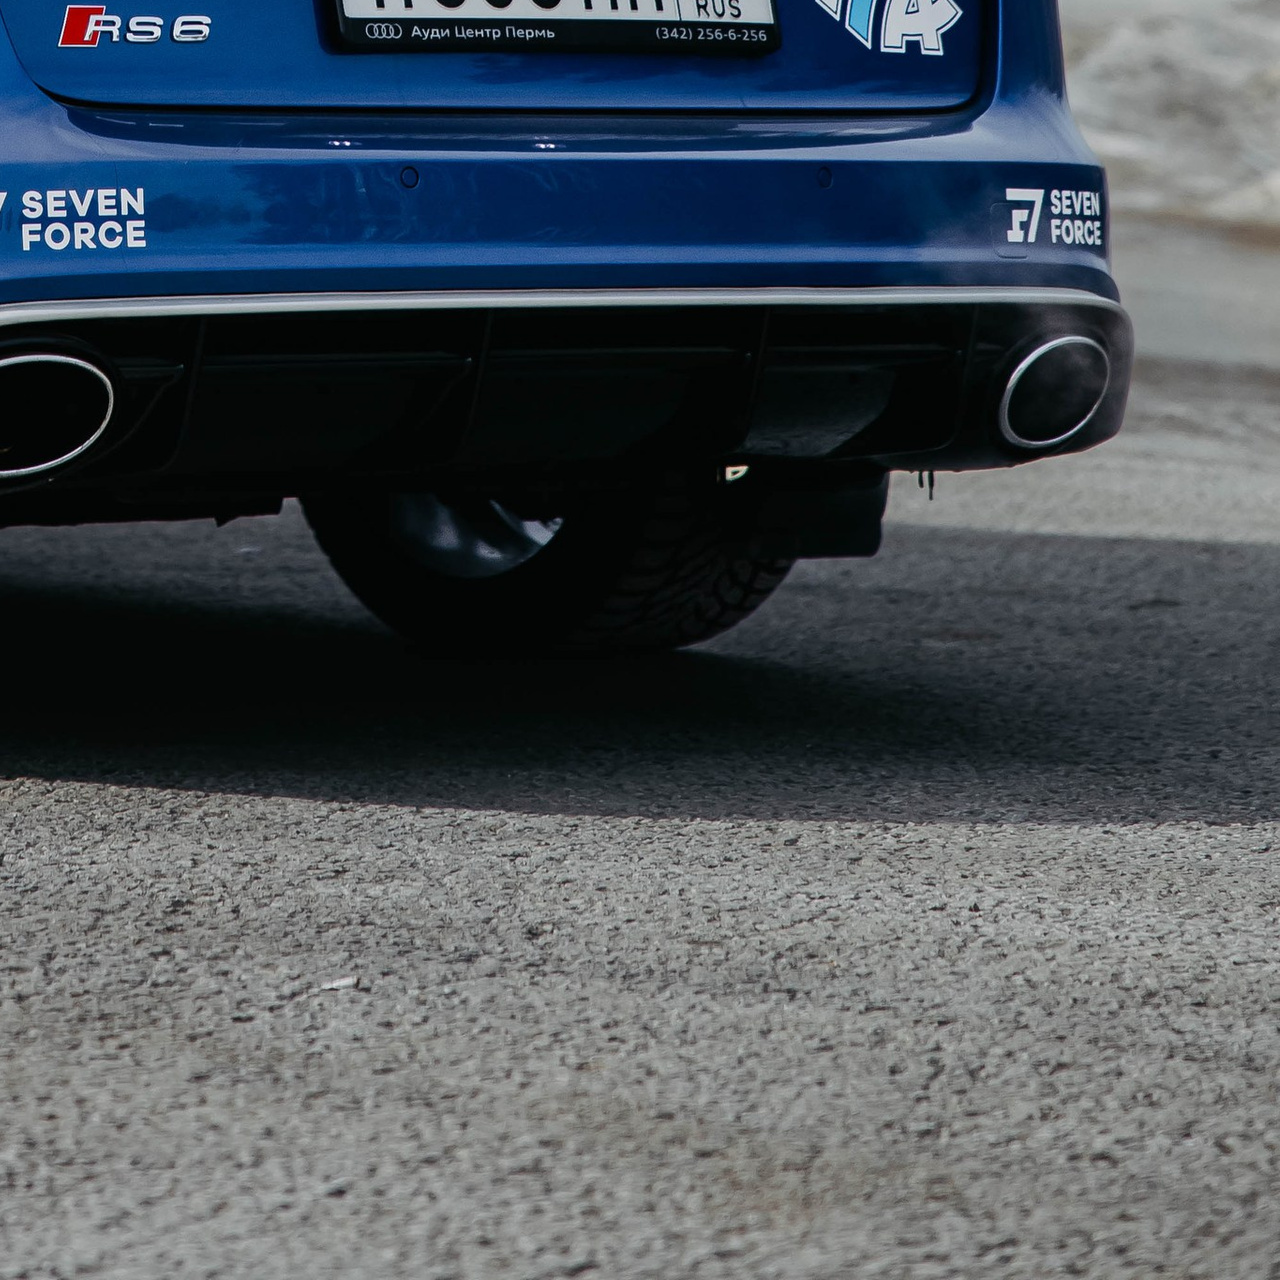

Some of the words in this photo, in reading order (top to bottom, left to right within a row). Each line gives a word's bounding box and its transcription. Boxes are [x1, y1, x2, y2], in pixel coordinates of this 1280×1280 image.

[411, 25, 450, 40] Ауди
[454, 25, 501, 40] Центр
[505, 25, 556, 40] Пермь
[655, 27, 693, 40] (342)
[697, 28, 768, 41] 256-6-256
[21, 188, 145, 219] SEVEN
[1050, 189, 1101, 216] SEVEN
[21, 220, 147, 251] FORCE
[1050, 218, 1102, 246] FORCE
